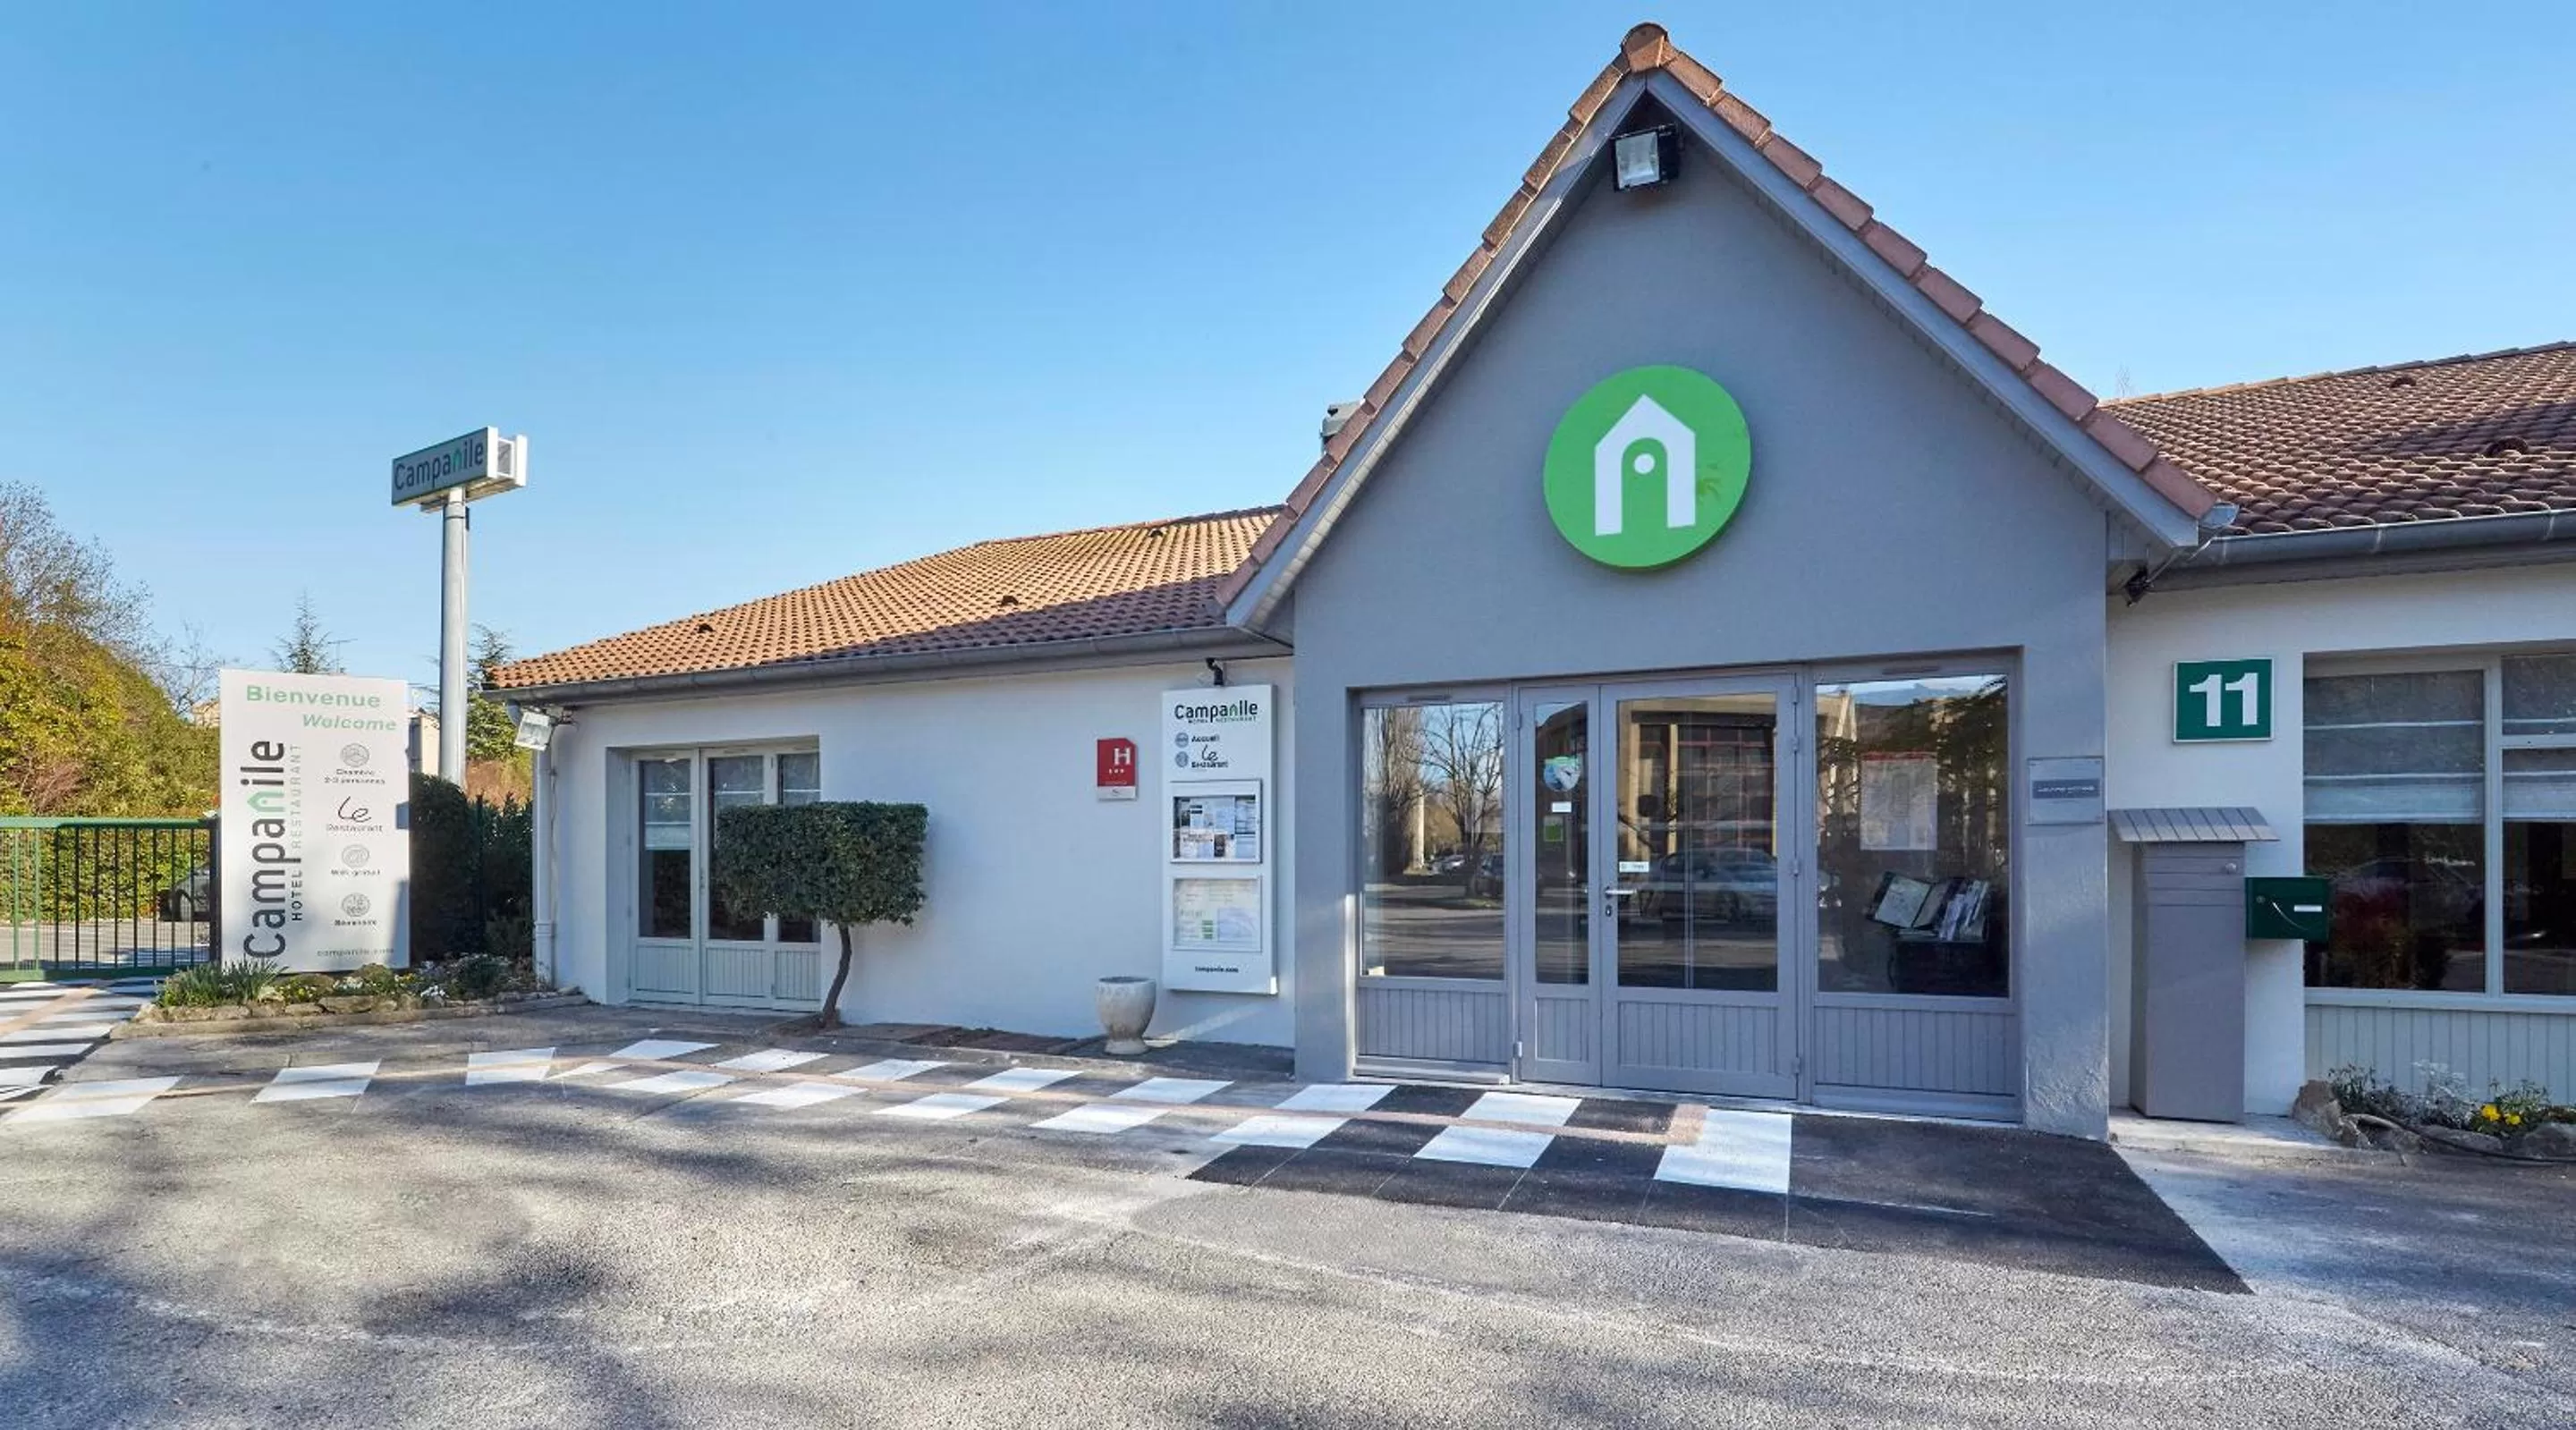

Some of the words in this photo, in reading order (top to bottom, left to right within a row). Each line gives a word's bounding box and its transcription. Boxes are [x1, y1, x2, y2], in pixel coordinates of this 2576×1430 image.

[394, 437, 484, 490] Campanile
[247, 684, 381, 708] Bienvenue
[1174, 699, 1258, 723] Campanile
[2189, 672, 2258, 727] 11
[302, 715, 397, 731] Welcome
[1114, 748, 1131, 766] H
[290, 744, 302, 850] RESTAURANT
[338, 796, 372, 823] Le
[240, 740, 302, 959] Campanile
[292, 869, 303, 922] HOTEL
